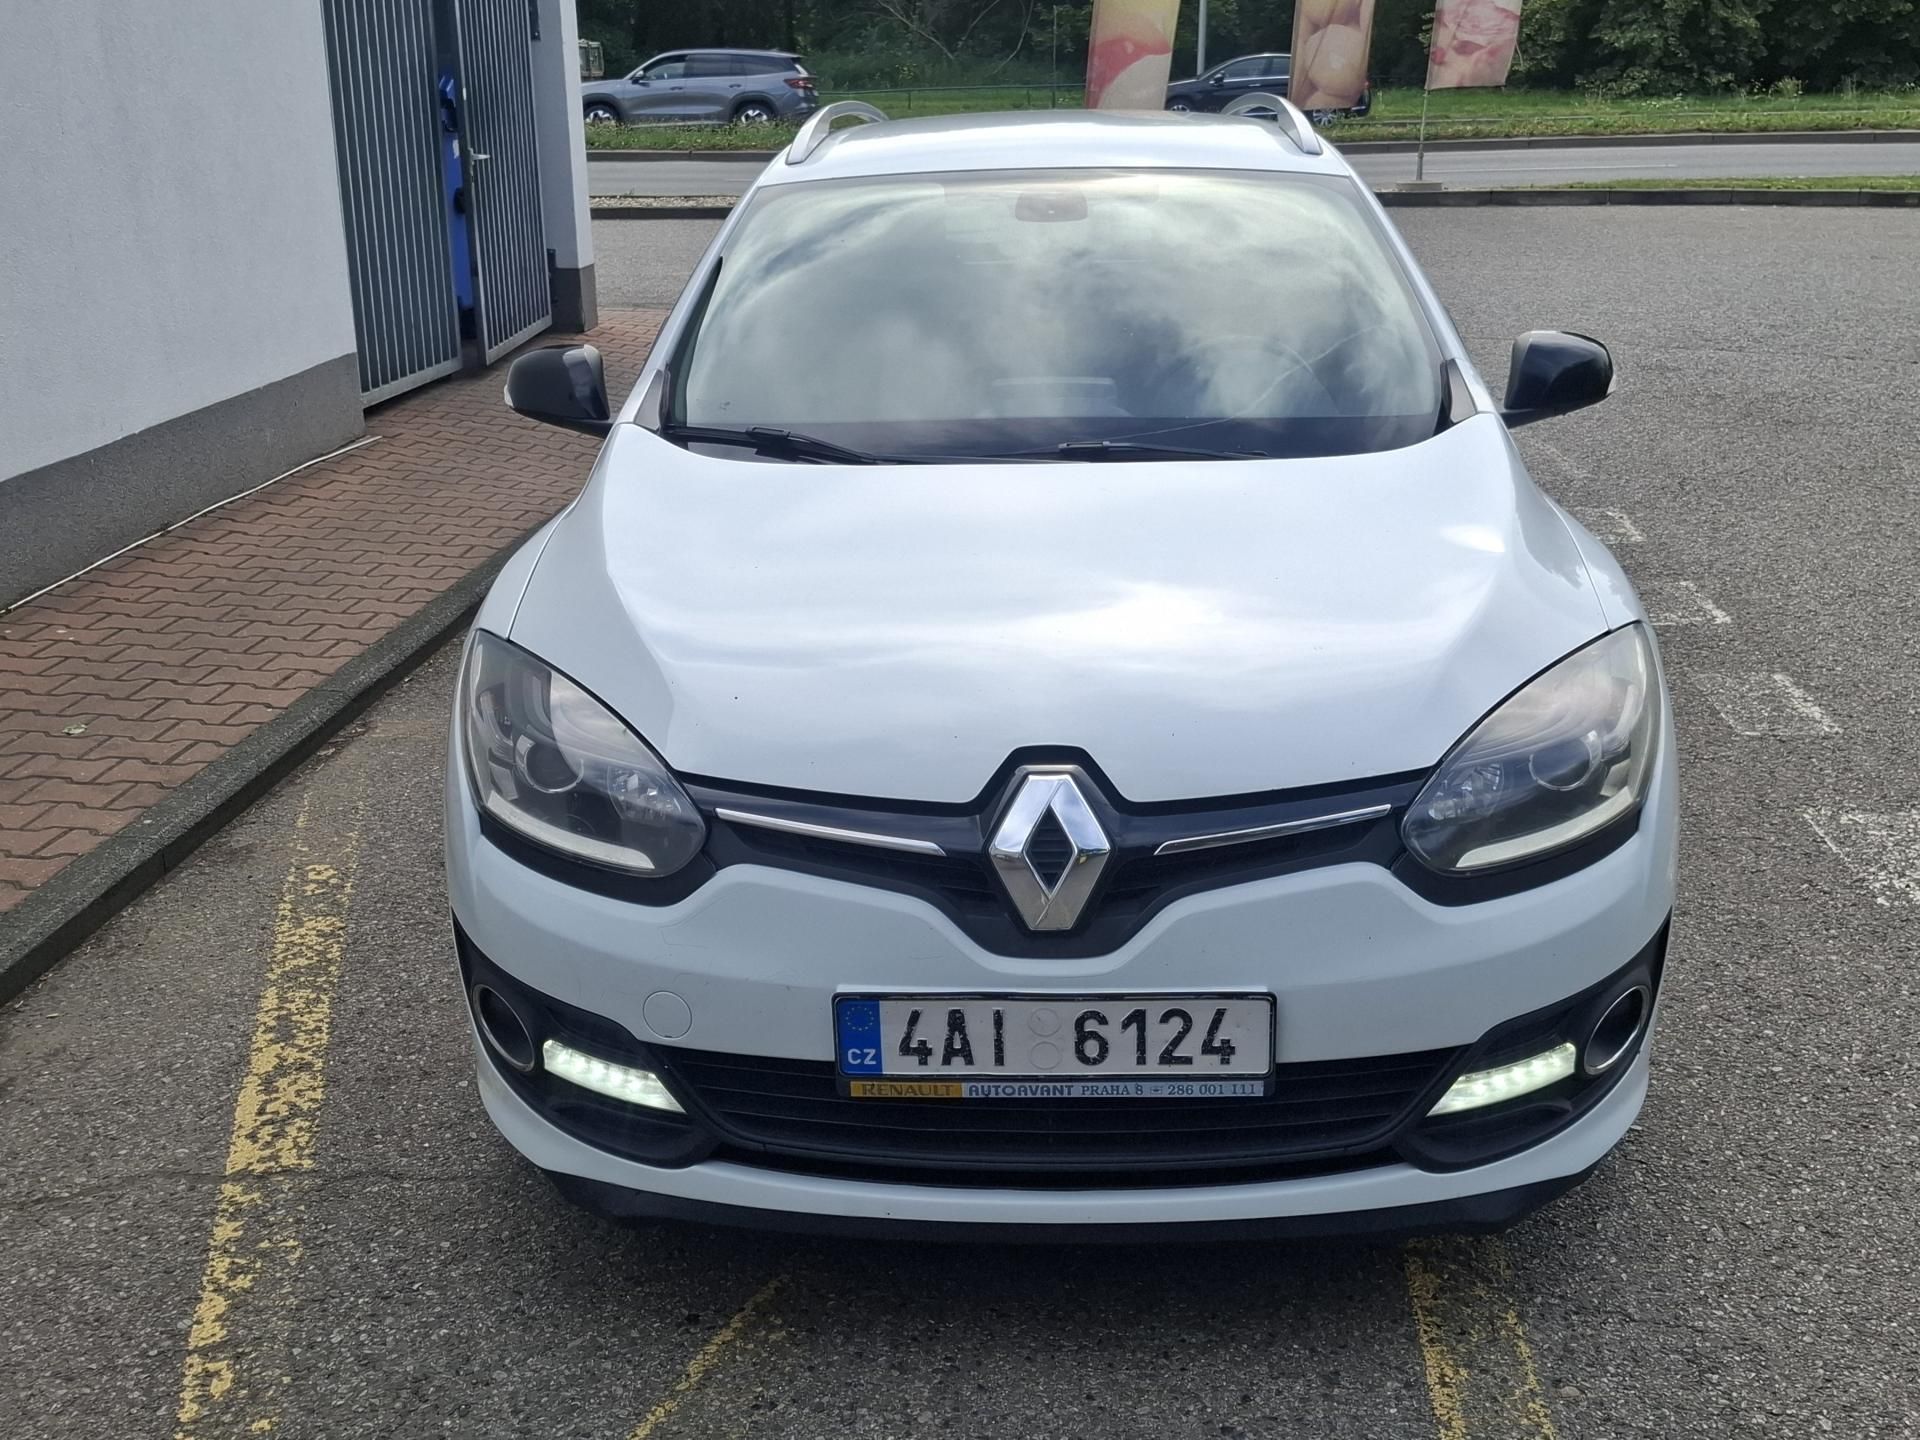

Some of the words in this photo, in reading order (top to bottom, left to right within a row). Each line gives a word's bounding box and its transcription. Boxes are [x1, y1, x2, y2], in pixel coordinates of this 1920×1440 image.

[899, 1008, 1004, 1066] 4AI
[1074, 1008, 1236, 1066] 6124
[847, 1048, 877, 1065] CZ
[862, 1083, 955, 1097] RENAULT
[968, 1084, 1074, 1097] AUTOAVANT
[1081, 1084, 1130, 1096] PRAHA
[1135, 1084, 1144, 1095] 8
[1167, 1083, 1194, 1096] 286
[1199, 1083, 1224, 1096] 001
[1232, 1083, 1256, 1095] 111
